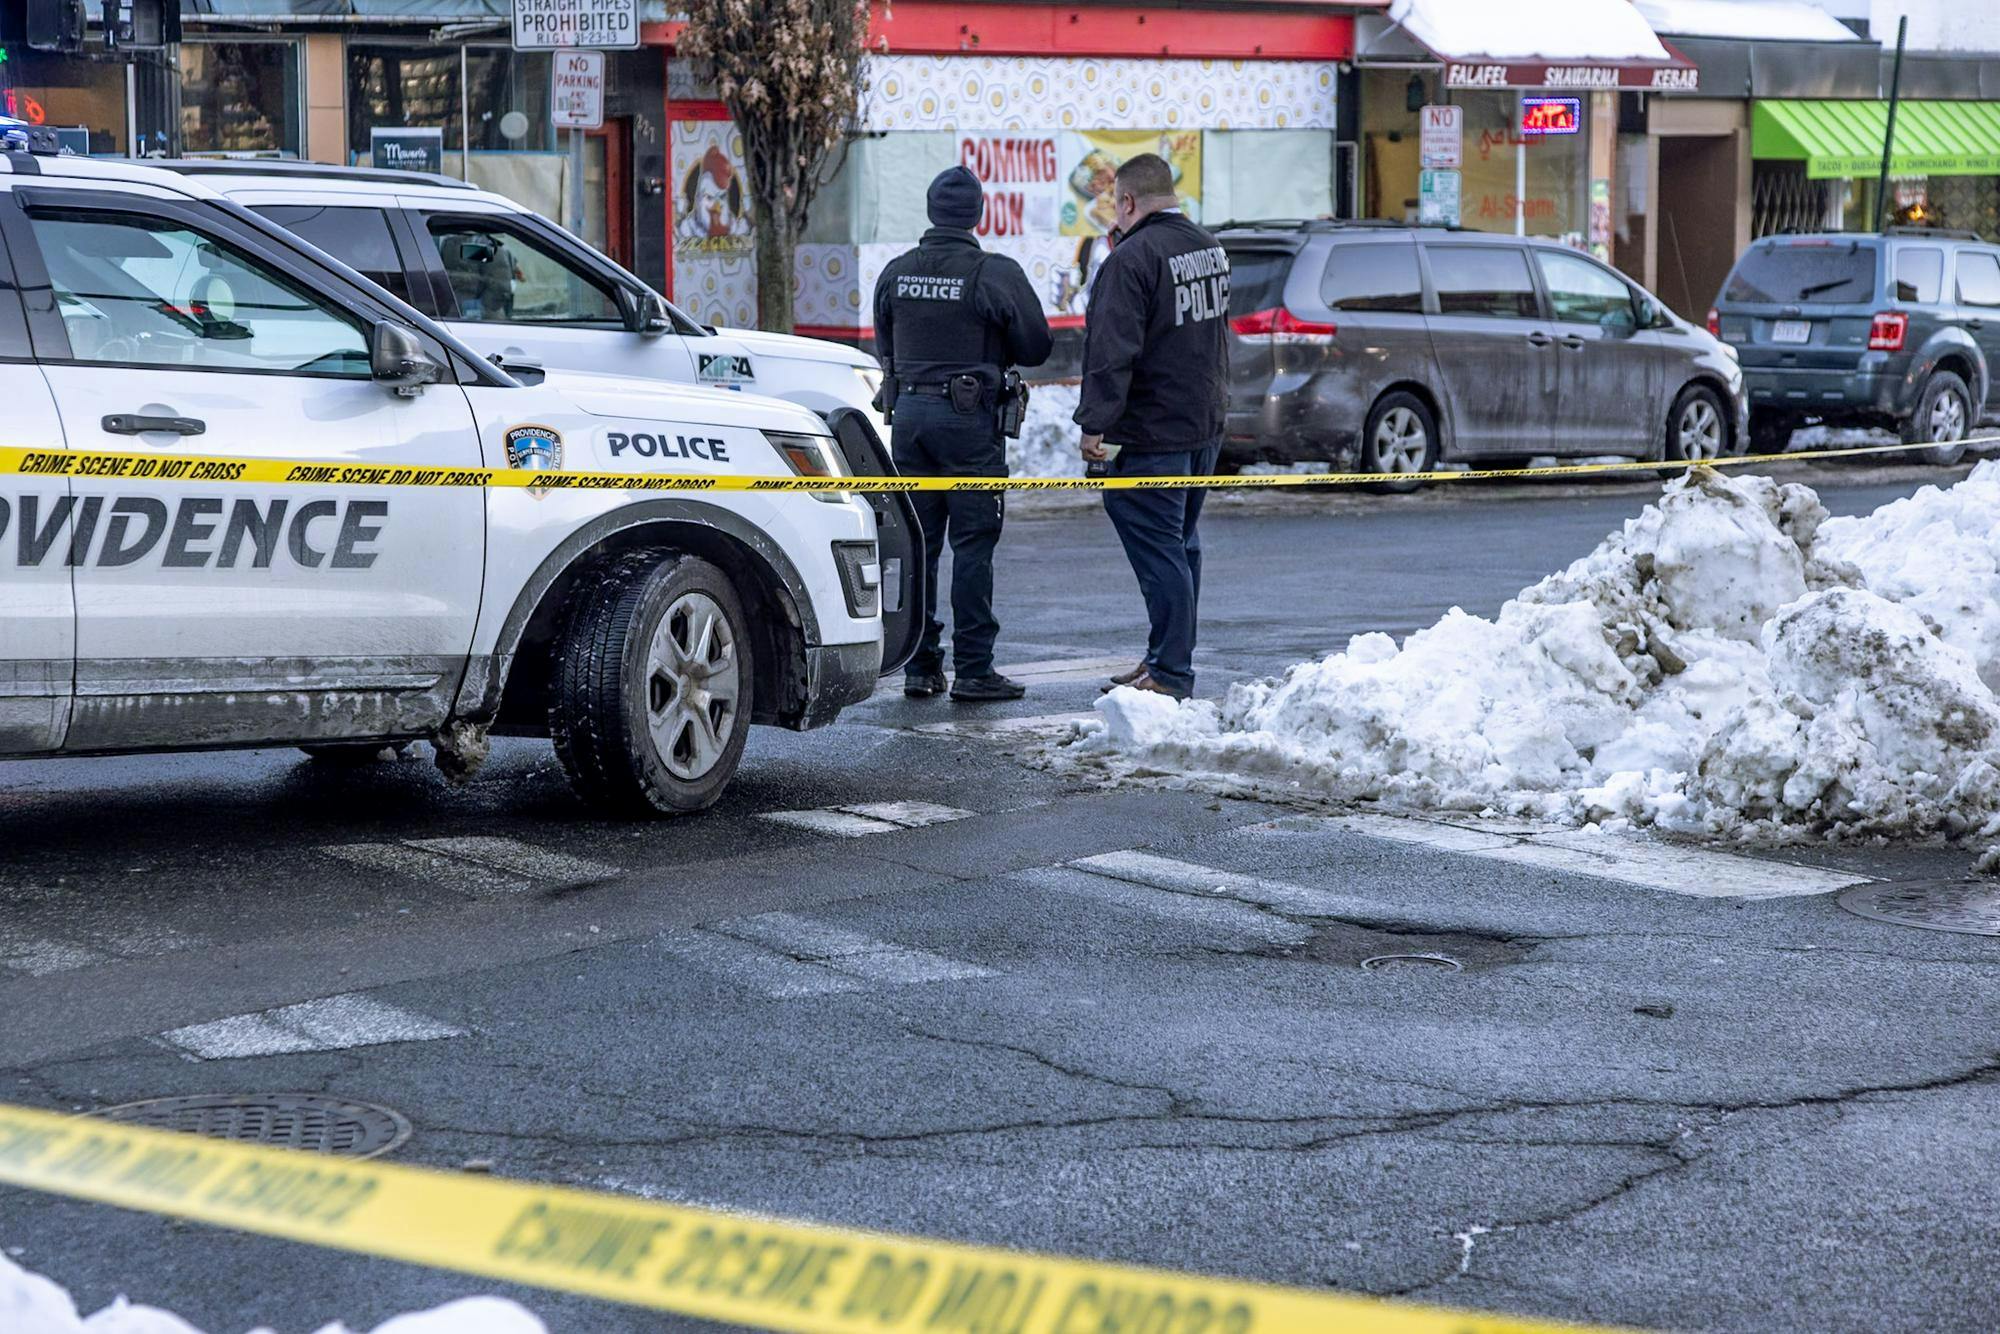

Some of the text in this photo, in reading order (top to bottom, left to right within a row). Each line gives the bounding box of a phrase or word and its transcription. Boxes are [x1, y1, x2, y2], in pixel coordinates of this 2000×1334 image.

[519, 0, 631, 11] STRAIGHT PIPES
[522, 13, 629, 32] PROHIBITED
[569, 59, 588, 72] NO
[556, 74, 599, 89] PARKING
[1447, 64, 1698, 88] FALAFEL SHAWARMA KEBAB
[1431, 109, 1453, 127] NO
[961, 137, 1057, 183] COMING
[976, 192, 1024, 237] OON
[897, 275, 965, 286] PROVIDENCE
[898, 283, 961, 300] POLICE
[510, 428, 557, 441] PROVIDENCE
[607, 432, 730, 463] POLICE
[19, 453, 246, 480] CRIME SCENE DO NOT CROSS
[286, 466, 492, 486] CRIME SCENE DO NOT CROSS
[0, 495, 388, 568] VIDENCE
